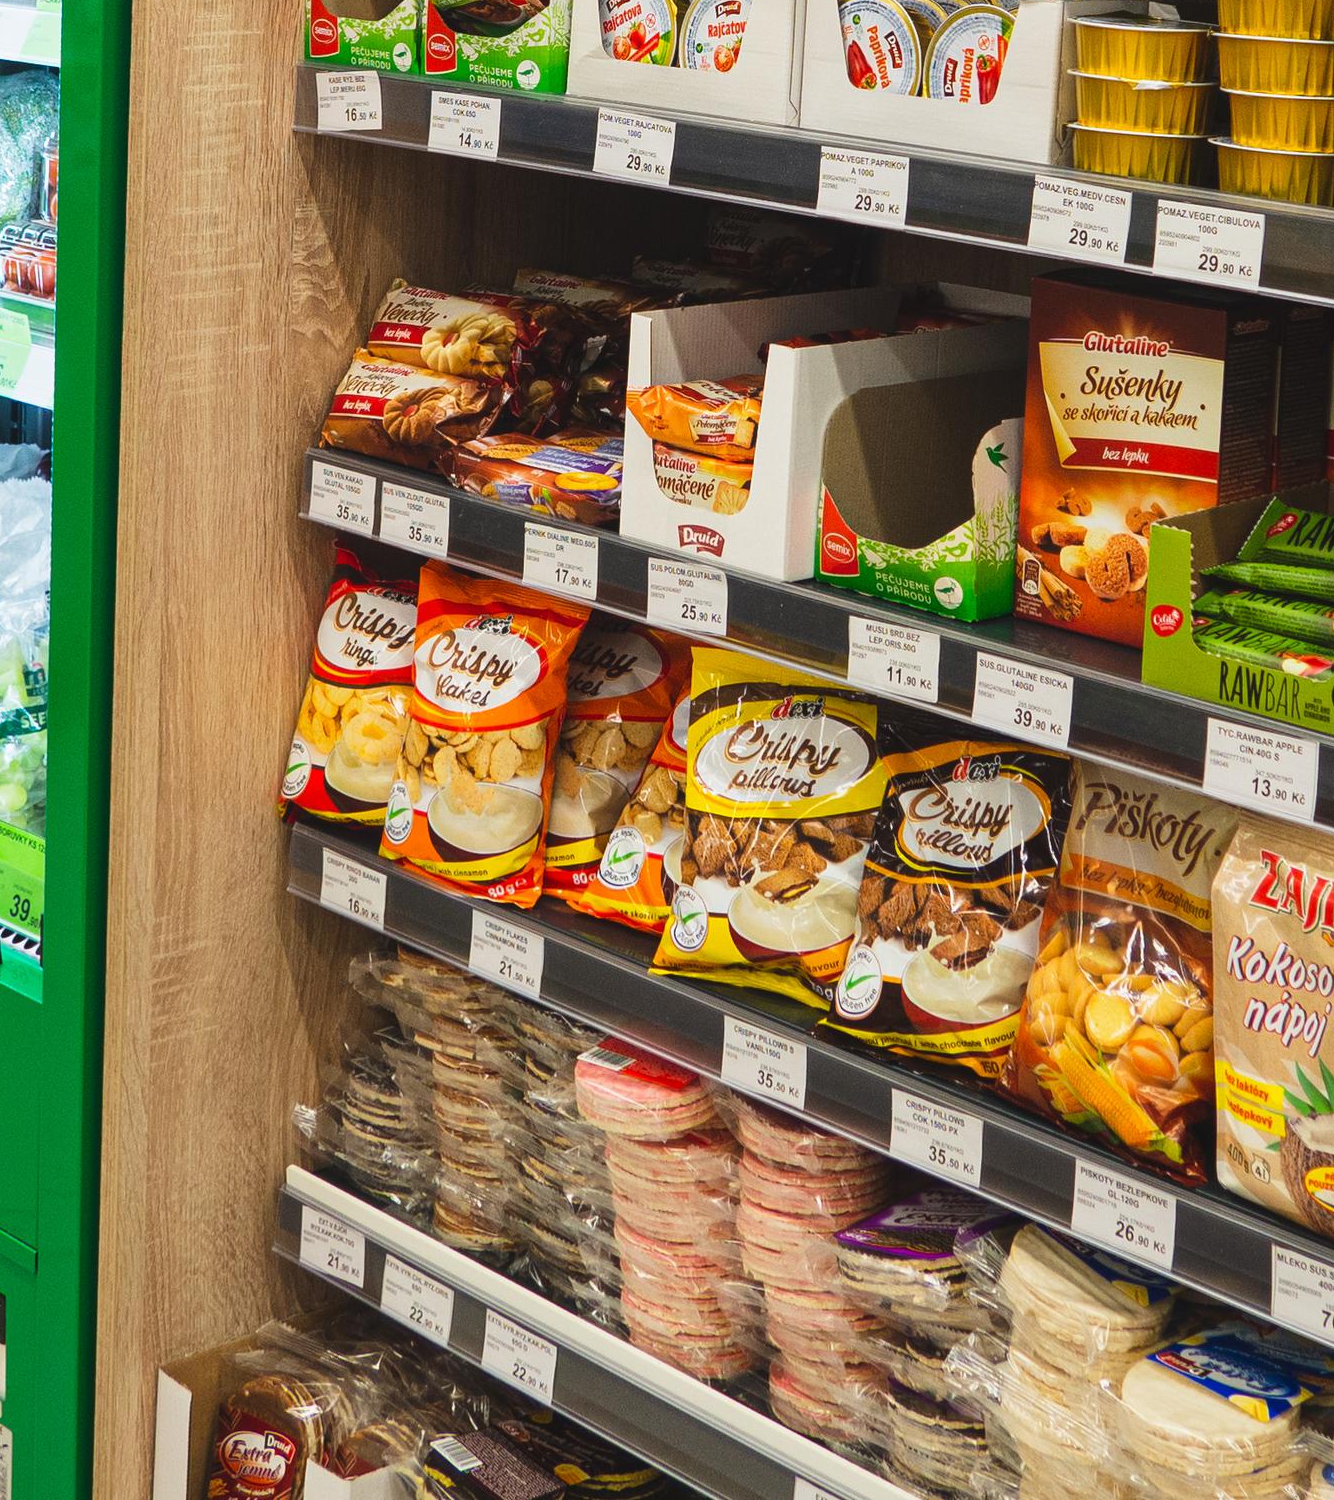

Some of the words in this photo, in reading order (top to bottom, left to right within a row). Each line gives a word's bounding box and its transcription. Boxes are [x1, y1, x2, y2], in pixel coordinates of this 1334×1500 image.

[1083, 332, 1170, 356] Glutaline
[1081, 366, 1183, 408] Sušenky
[1063, 407, 1078, 419] se
[1103, 448, 1119, 461] bez
[680, 528, 722, 549] Druid
[1219, 661, 1300, 718] RAWBAR
[1251, 777, 1287, 801] 13,90
[1291, 790, 1305, 804] Kč
[1244, 996, 1328, 1058] nápoj
